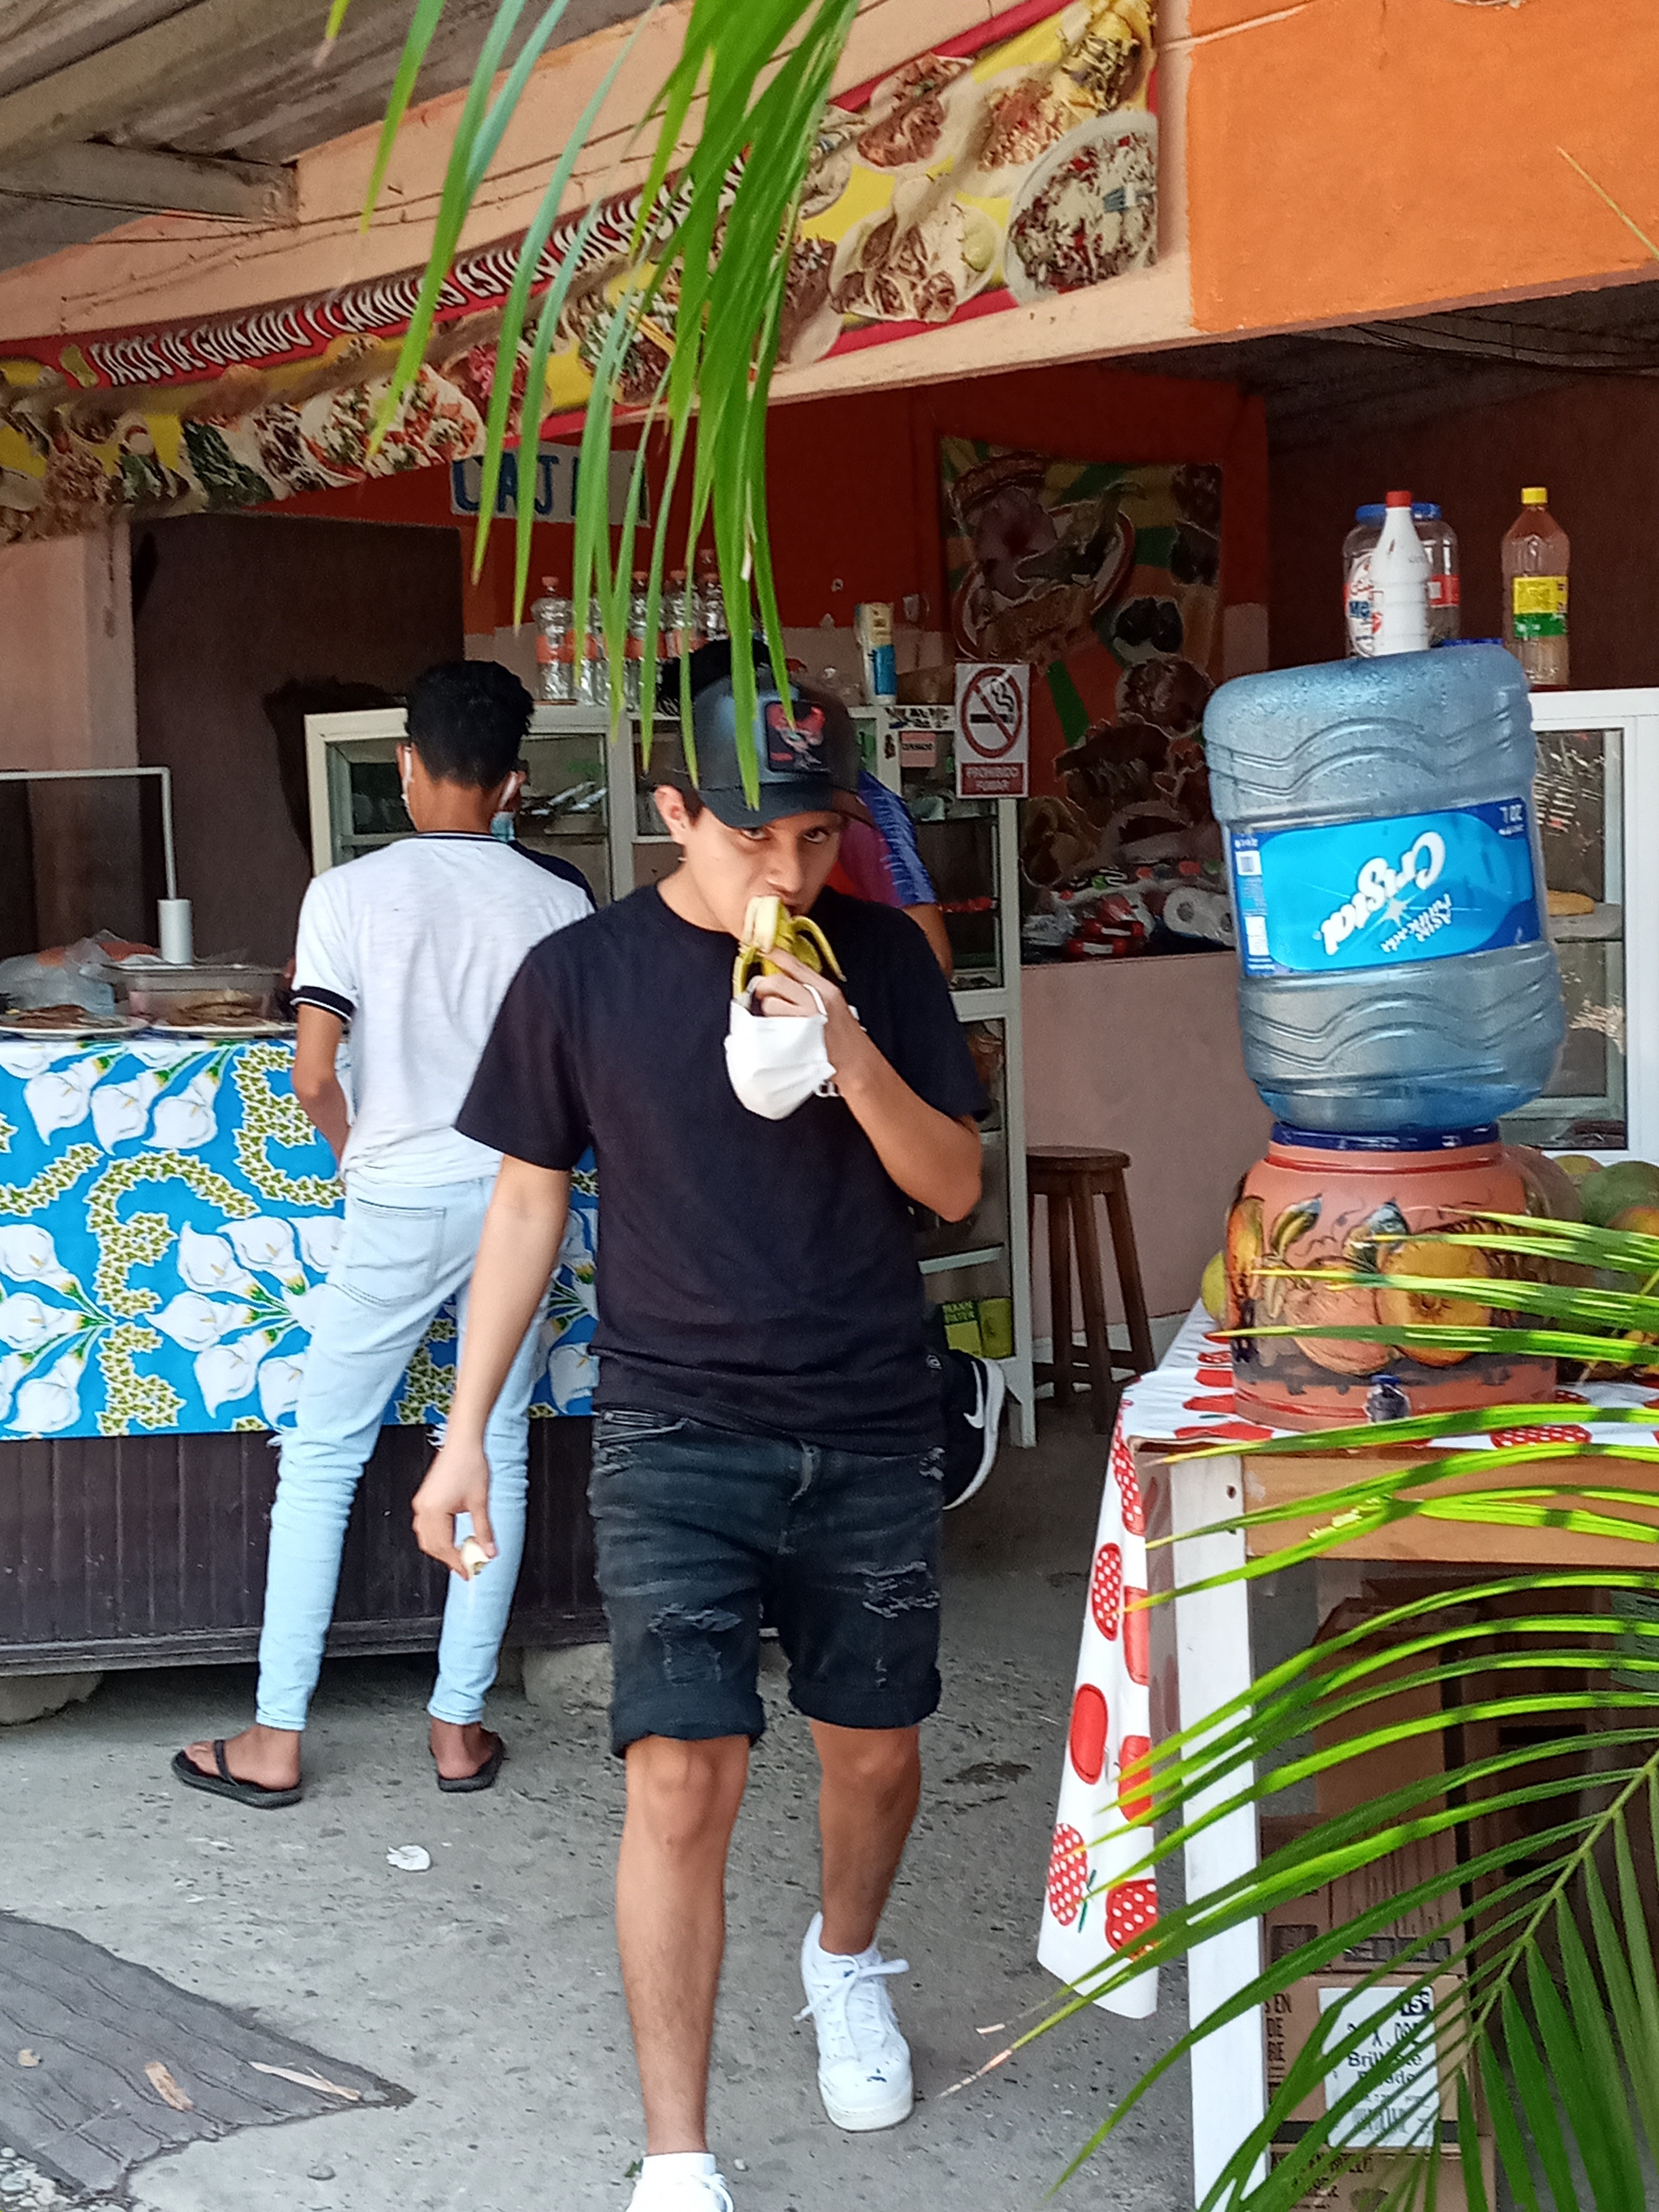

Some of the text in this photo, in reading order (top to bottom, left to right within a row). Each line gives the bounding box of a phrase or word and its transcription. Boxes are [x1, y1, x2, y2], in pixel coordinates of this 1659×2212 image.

[89, 332, 175, 386] TACOS
[161, 328, 207, 371] DE
[191, 305, 312, 366] GUISADO
[453, 451, 581, 516] CAJ
